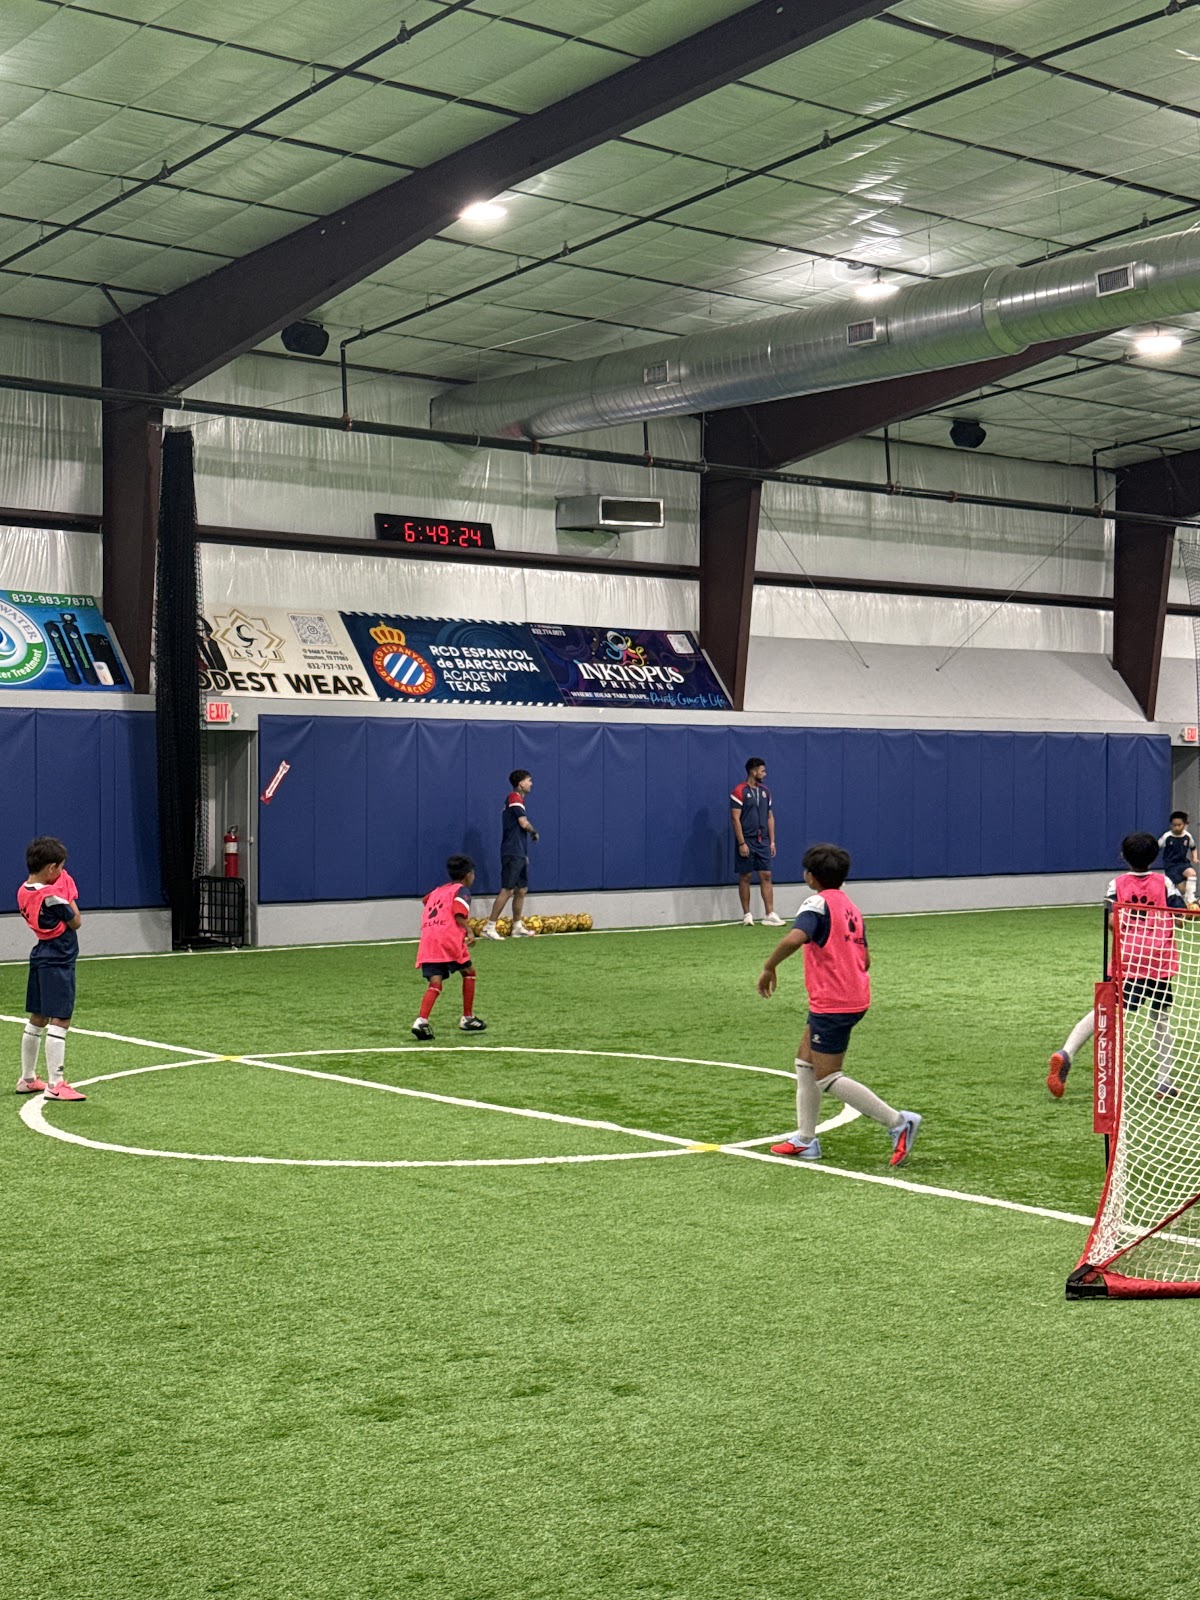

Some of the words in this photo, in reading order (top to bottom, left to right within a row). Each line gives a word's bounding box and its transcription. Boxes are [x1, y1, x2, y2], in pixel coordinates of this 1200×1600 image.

[404, 522, 482, 547] 6:49:24
[12, 593, 94, 606] 832-983-7878
[0, 605, 37, 640] WATER
[233, 648, 280, 659] ASLI
[375, 651, 384, 666] RCD
[382, 645, 428, 669] ESPANYOL
[428, 645, 460, 656] RCD
[461, 646, 534, 660] ESPANYOL
[10, 649, 42, 678] Treatment
[307, 662, 353, 670] 832-757-3210
[436, 658, 454, 668] de
[454, 658, 541, 672] BARCELONA
[443, 670, 508, 682] ACADEMY
[575, 662, 685, 684] INKTOPUS
[283, 673, 370, 696] WEAR
[380, 671, 392, 682] DE
[393, 672, 434, 693] BARCELONA
[445, 681, 491, 692] TEXAS
[600, 681, 675, 691] PRINTING
[209, 703, 229, 720] EXIT
[1098, 1002, 1107, 1114] POWERNET
